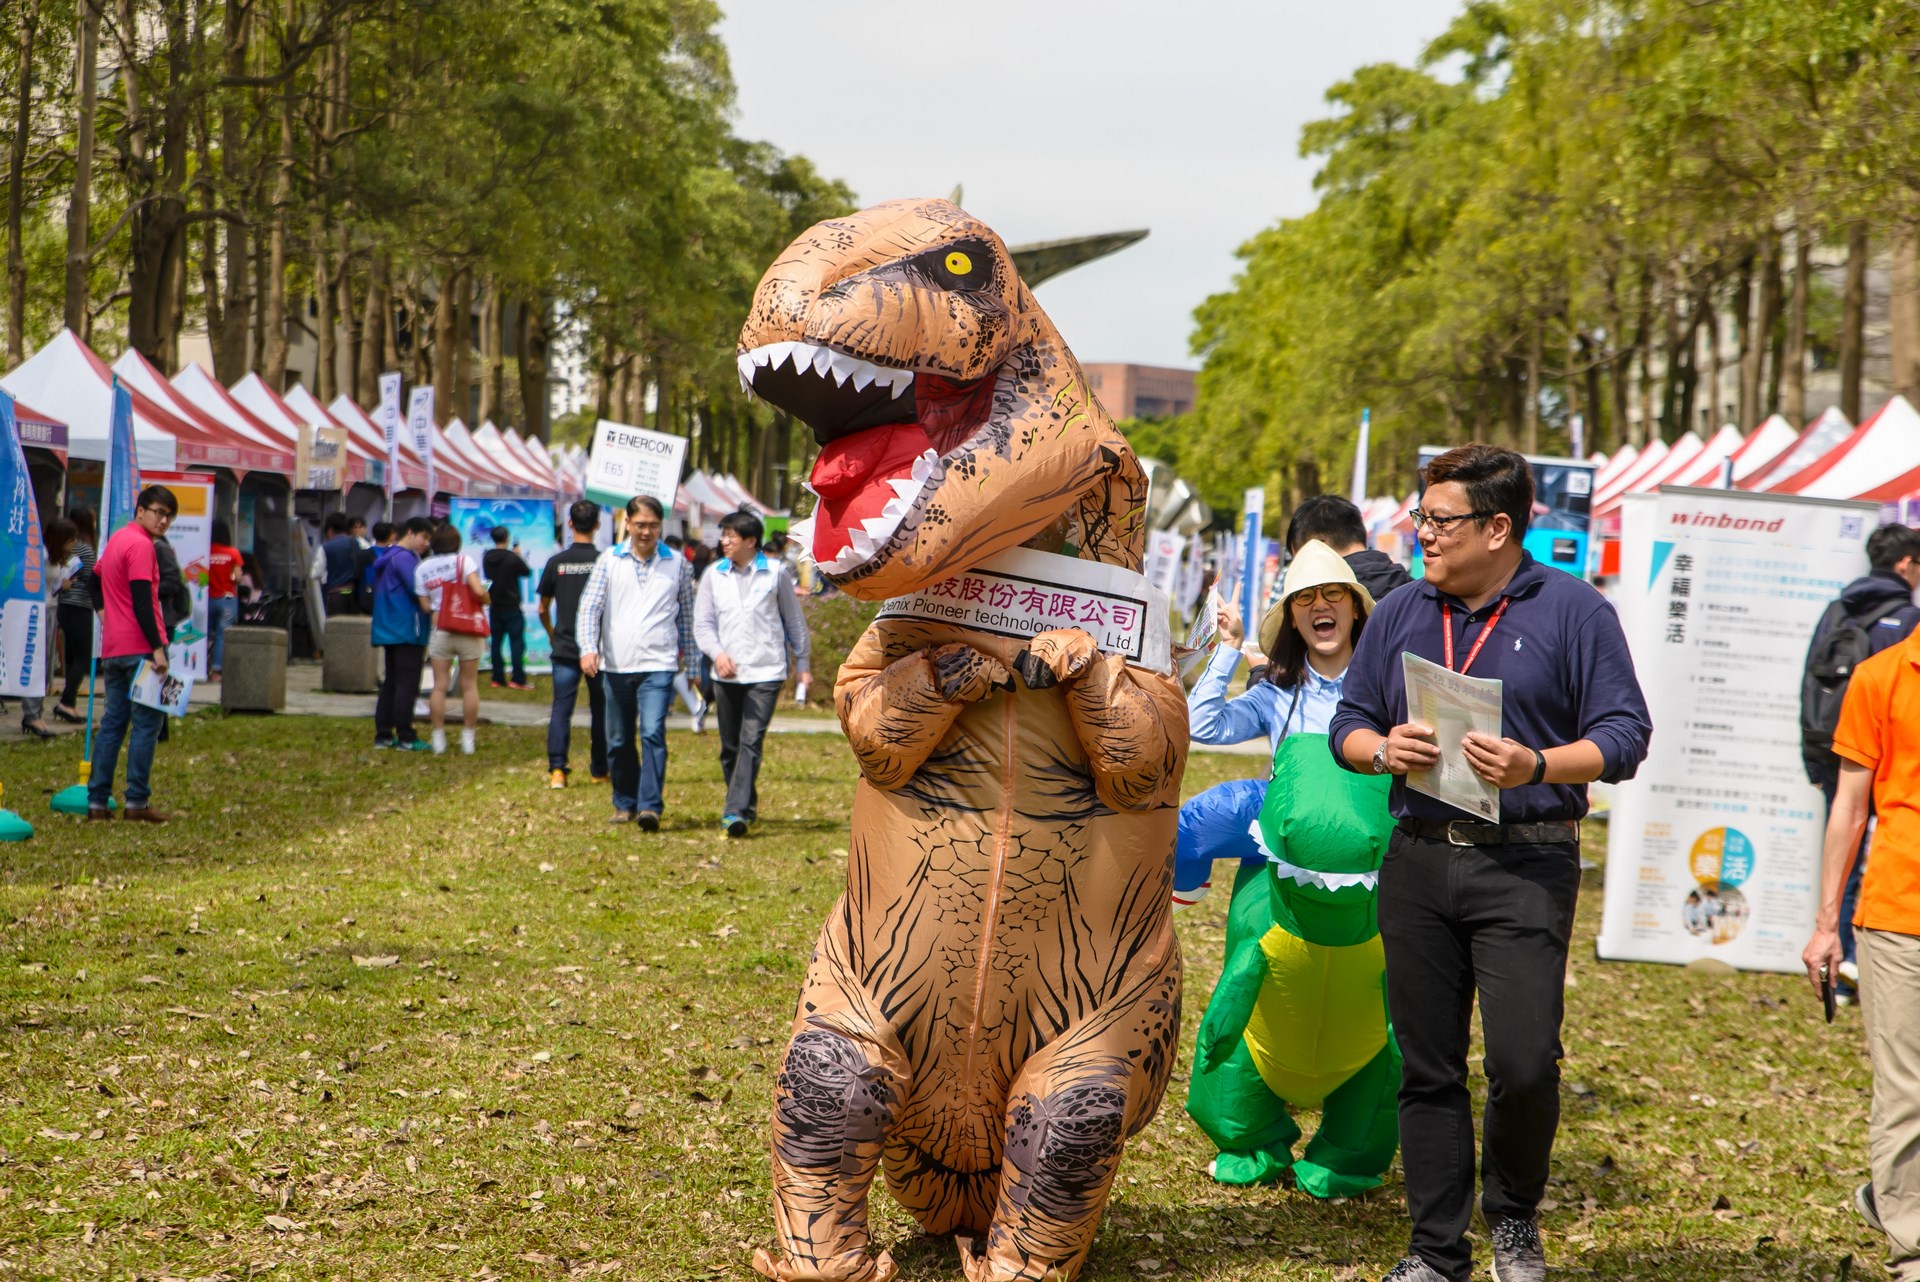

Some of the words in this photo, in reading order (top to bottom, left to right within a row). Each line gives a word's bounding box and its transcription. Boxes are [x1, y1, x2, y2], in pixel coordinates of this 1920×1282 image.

[618, 432, 674, 455] ENERCON
[1671, 512, 1786, 533] winbond
[913, 577, 1137, 632] 技股份有限公司
[913, 598, 970, 619] Pioneer
[1106, 631, 1134, 651] Ltd.
[1665, 554, 1694, 644] 幸福樂活
